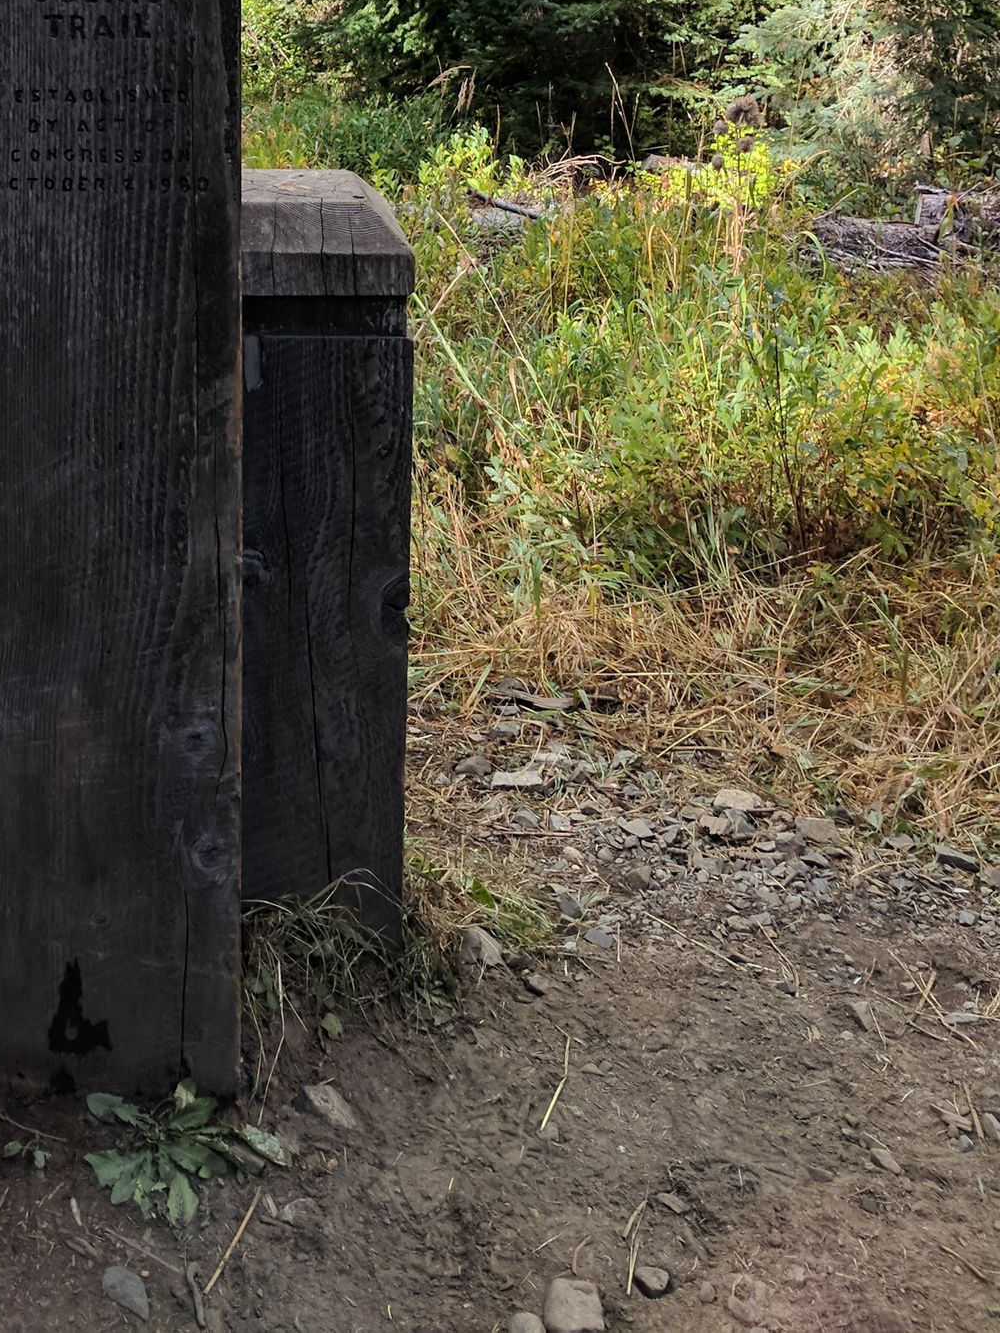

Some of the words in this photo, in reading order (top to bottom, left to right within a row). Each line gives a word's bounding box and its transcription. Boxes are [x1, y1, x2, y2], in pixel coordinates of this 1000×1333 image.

[43, 13, 151, 41] TRAIL
[27, 118, 59, 134] BY
[76, 118, 127, 133] ACT
[10, 147, 144, 164] CONGRESS
[161, 147, 191, 164] ON
